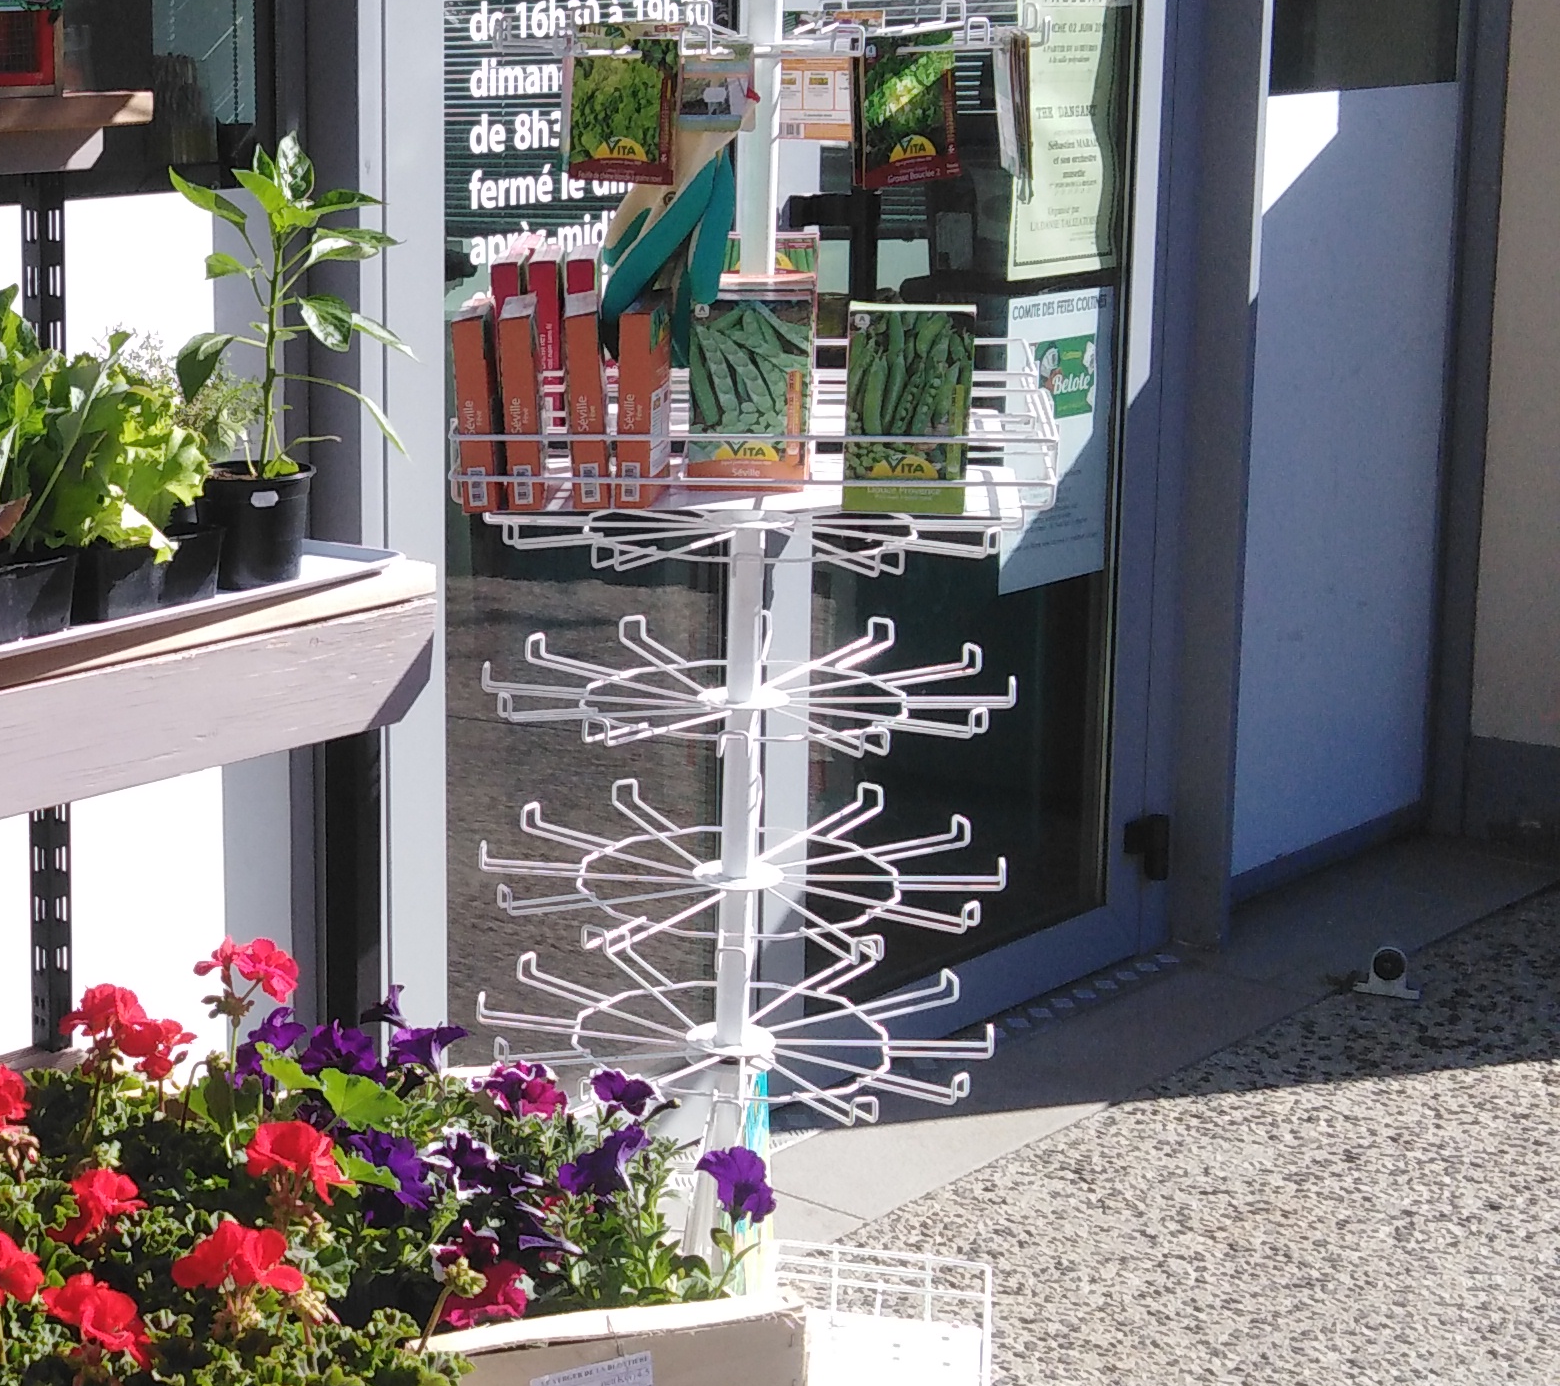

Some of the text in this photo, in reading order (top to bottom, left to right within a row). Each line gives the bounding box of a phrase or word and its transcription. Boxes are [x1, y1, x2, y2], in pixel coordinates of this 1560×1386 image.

[470, 114, 506, 154] de
[602, 138, 637, 156] VITA
[898, 137, 927, 155] VITA
[469, 165, 553, 210] fermé
[1012, 302, 1041, 320] COMITE
[1042, 300, 1055, 316] DES
[1052, 372, 1091, 395] Belote
[510, 397, 522, 434] Séville
[577, 395, 590, 432] Séville
[624, 393, 635, 430] Séville
[723, 440, 767, 458] VITA
[731, 467, 761, 477] Séville
[884, 455, 925, 474] VITA
